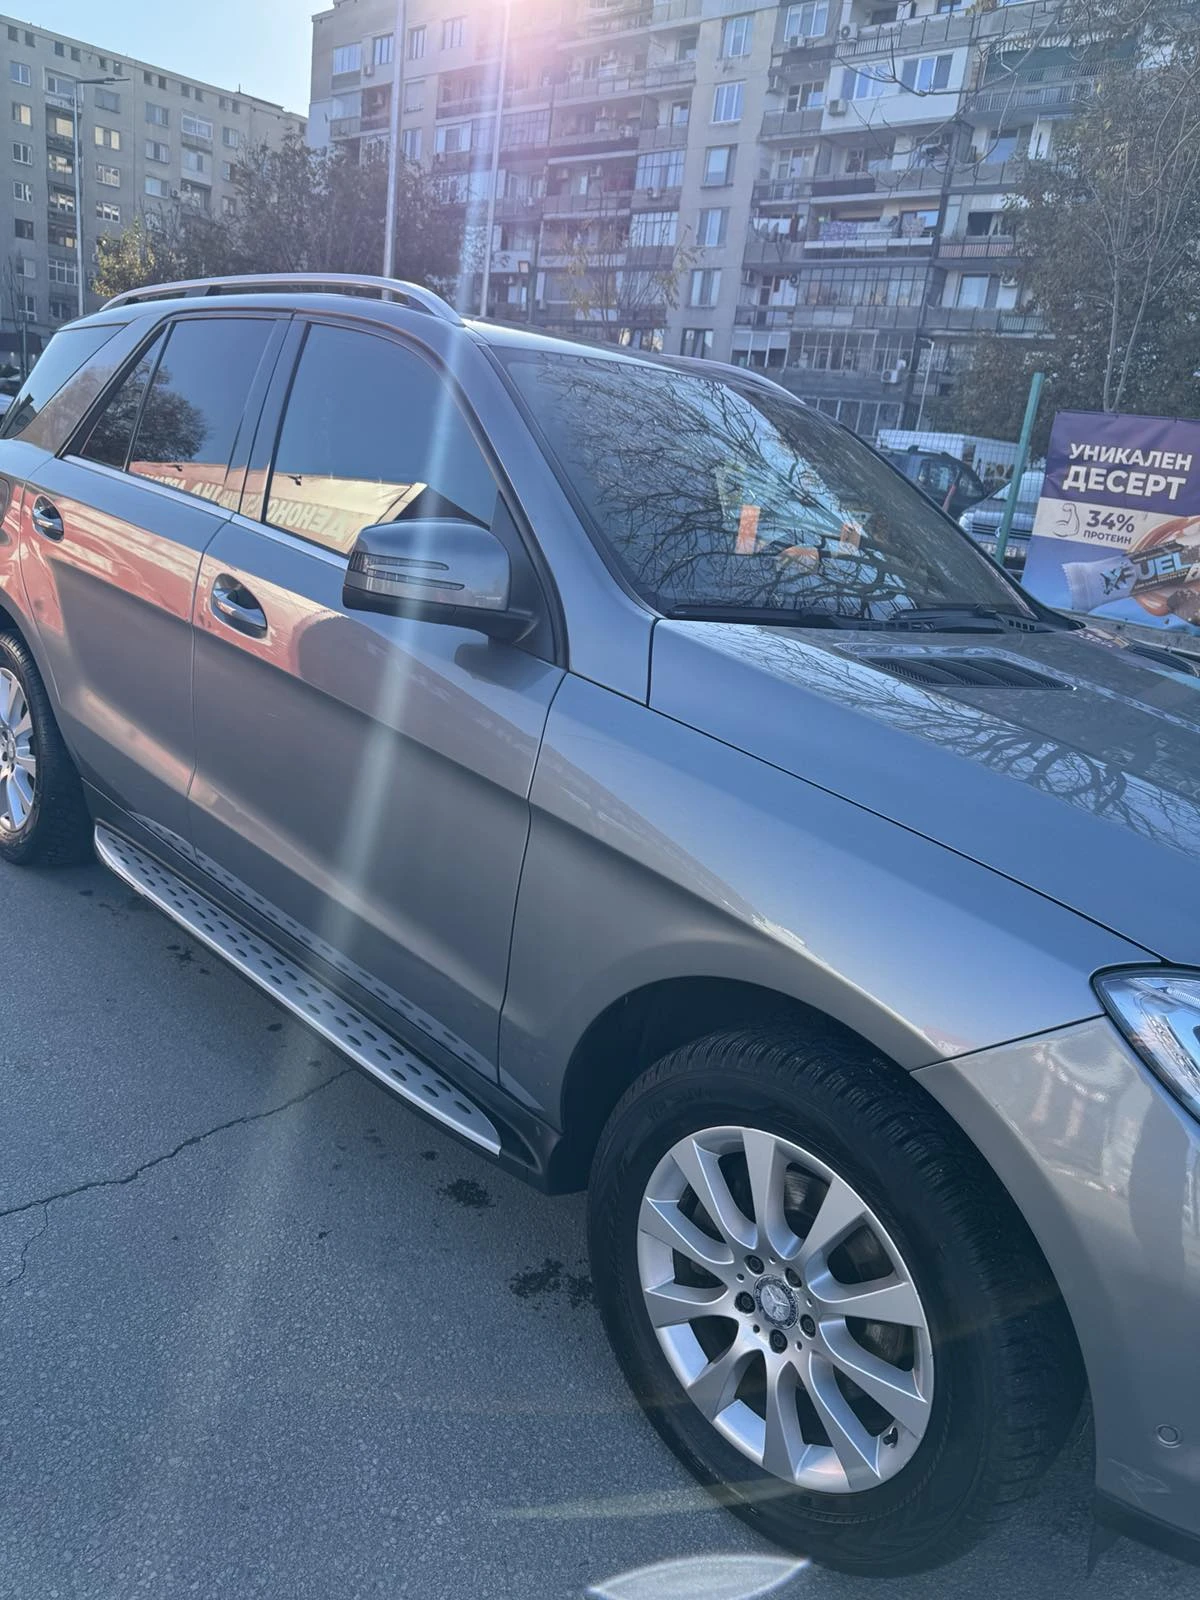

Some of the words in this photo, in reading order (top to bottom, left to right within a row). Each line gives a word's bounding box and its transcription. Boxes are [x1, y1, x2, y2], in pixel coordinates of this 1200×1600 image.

[1069, 443, 1192, 471] УНИКАЛЕН
[1062, 465, 1187, 500] ДЕСЕРТ
[1086, 510, 1135, 533] 34%
[1083, 530, 1132, 544] ПРОТЕИН
